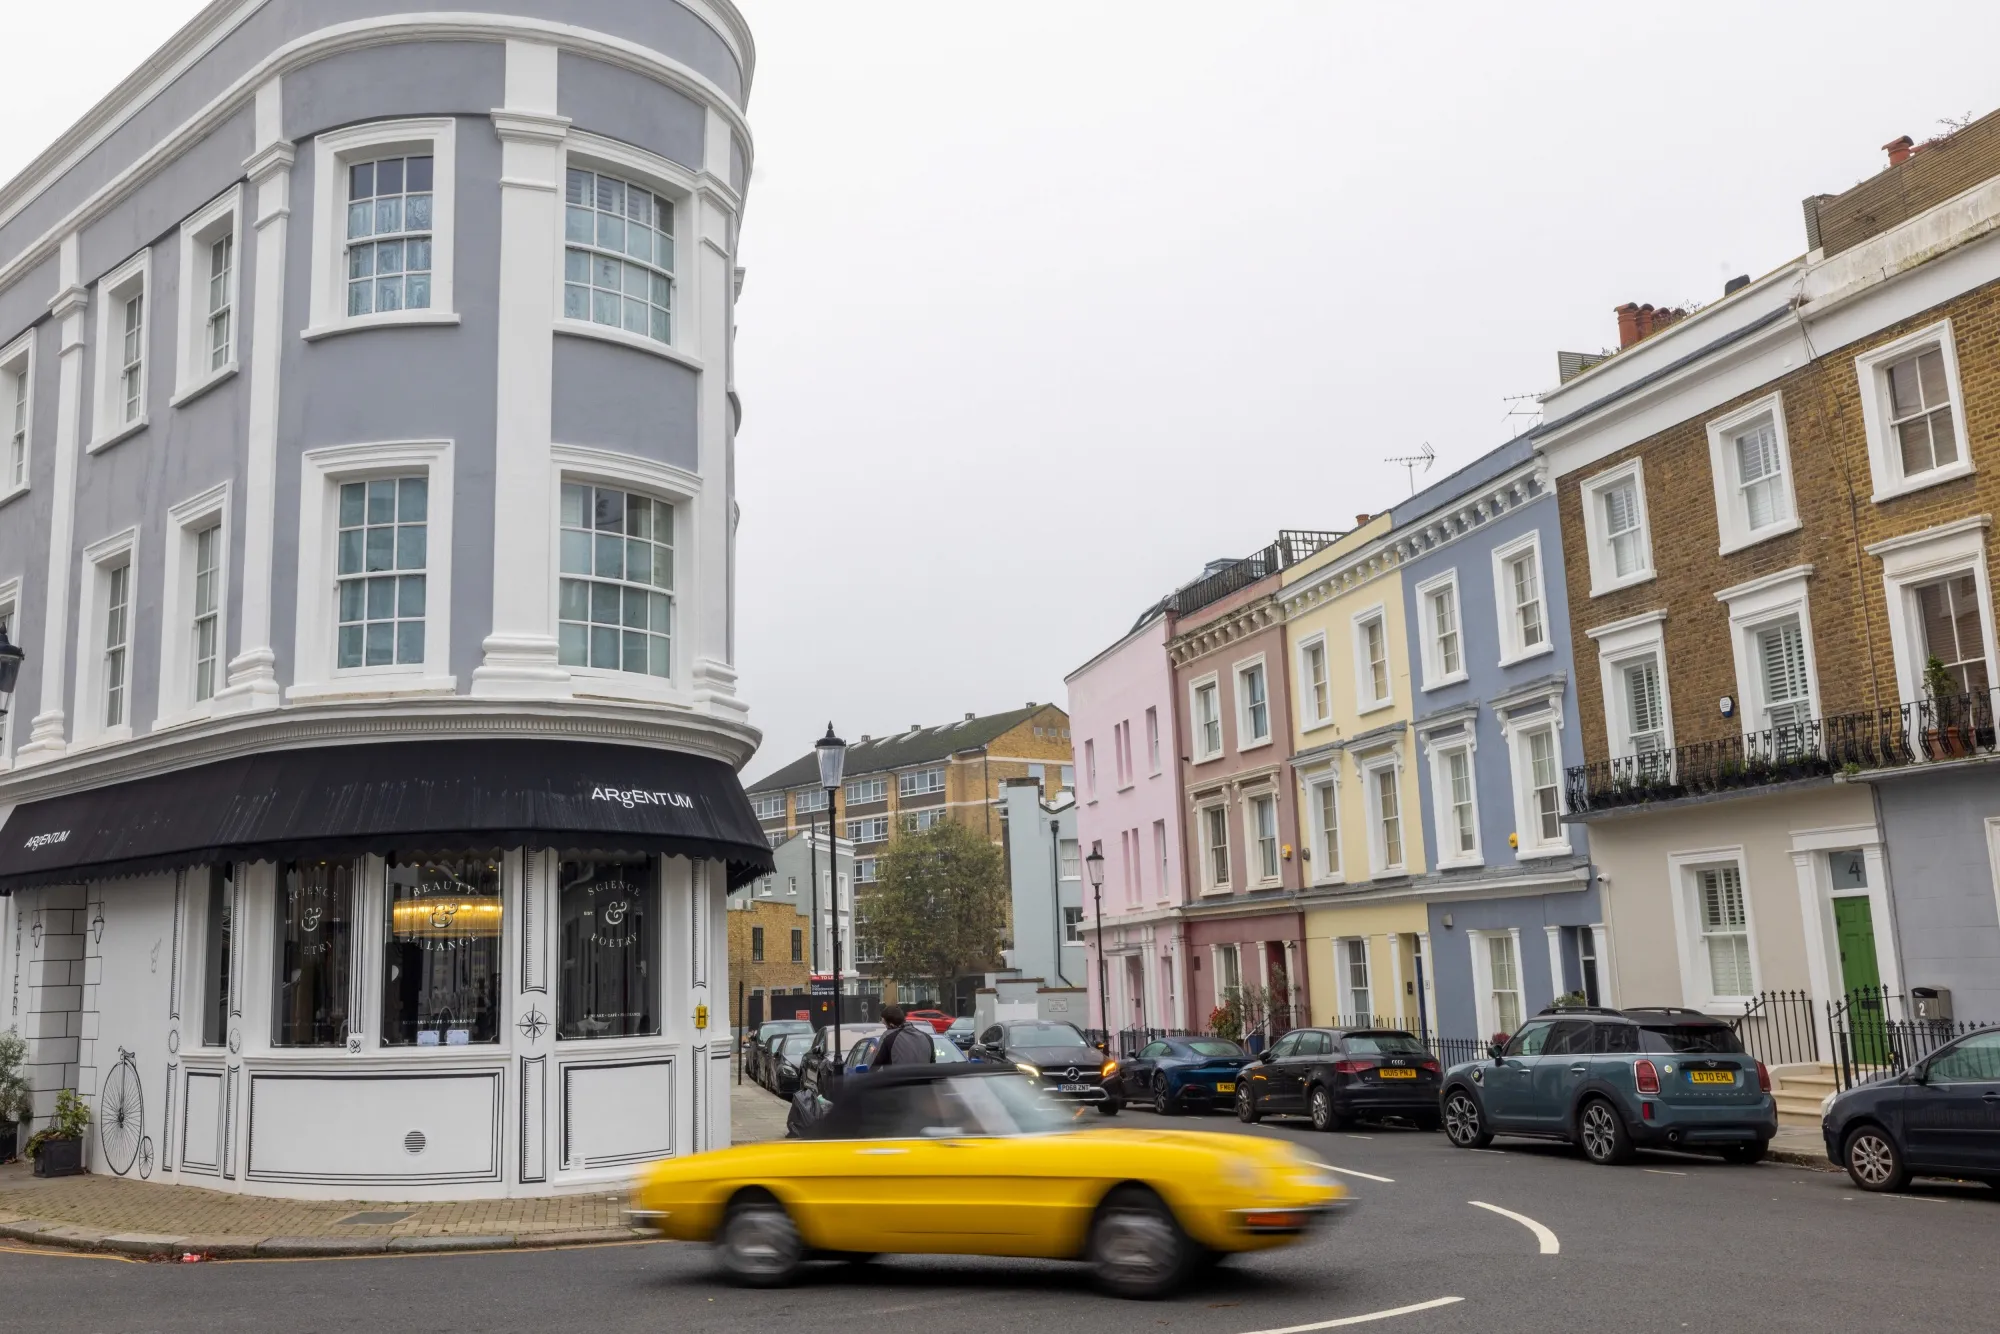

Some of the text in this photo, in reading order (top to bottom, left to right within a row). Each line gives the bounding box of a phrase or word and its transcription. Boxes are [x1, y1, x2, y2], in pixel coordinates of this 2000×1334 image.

[592, 787, 693, 809] ARgENTUM
[1848, 855, 1862, 882] 4
[289, 886, 338, 903] SCIENCE
[413, 881, 477, 896] BEAUTY
[587, 880, 641, 897] SCIENCE
[301, 907, 322, 932] &
[429, 902, 458, 928] &
[605, 901, 628, 925] &
[407, 932, 478, 951] LANCE
[590, 932, 637, 947] POETRY
[698, 1007, 707, 1026] H
[1919, 1002, 1926, 1017] 2
[1693, 1072, 1732, 1081] LD70 EHL
